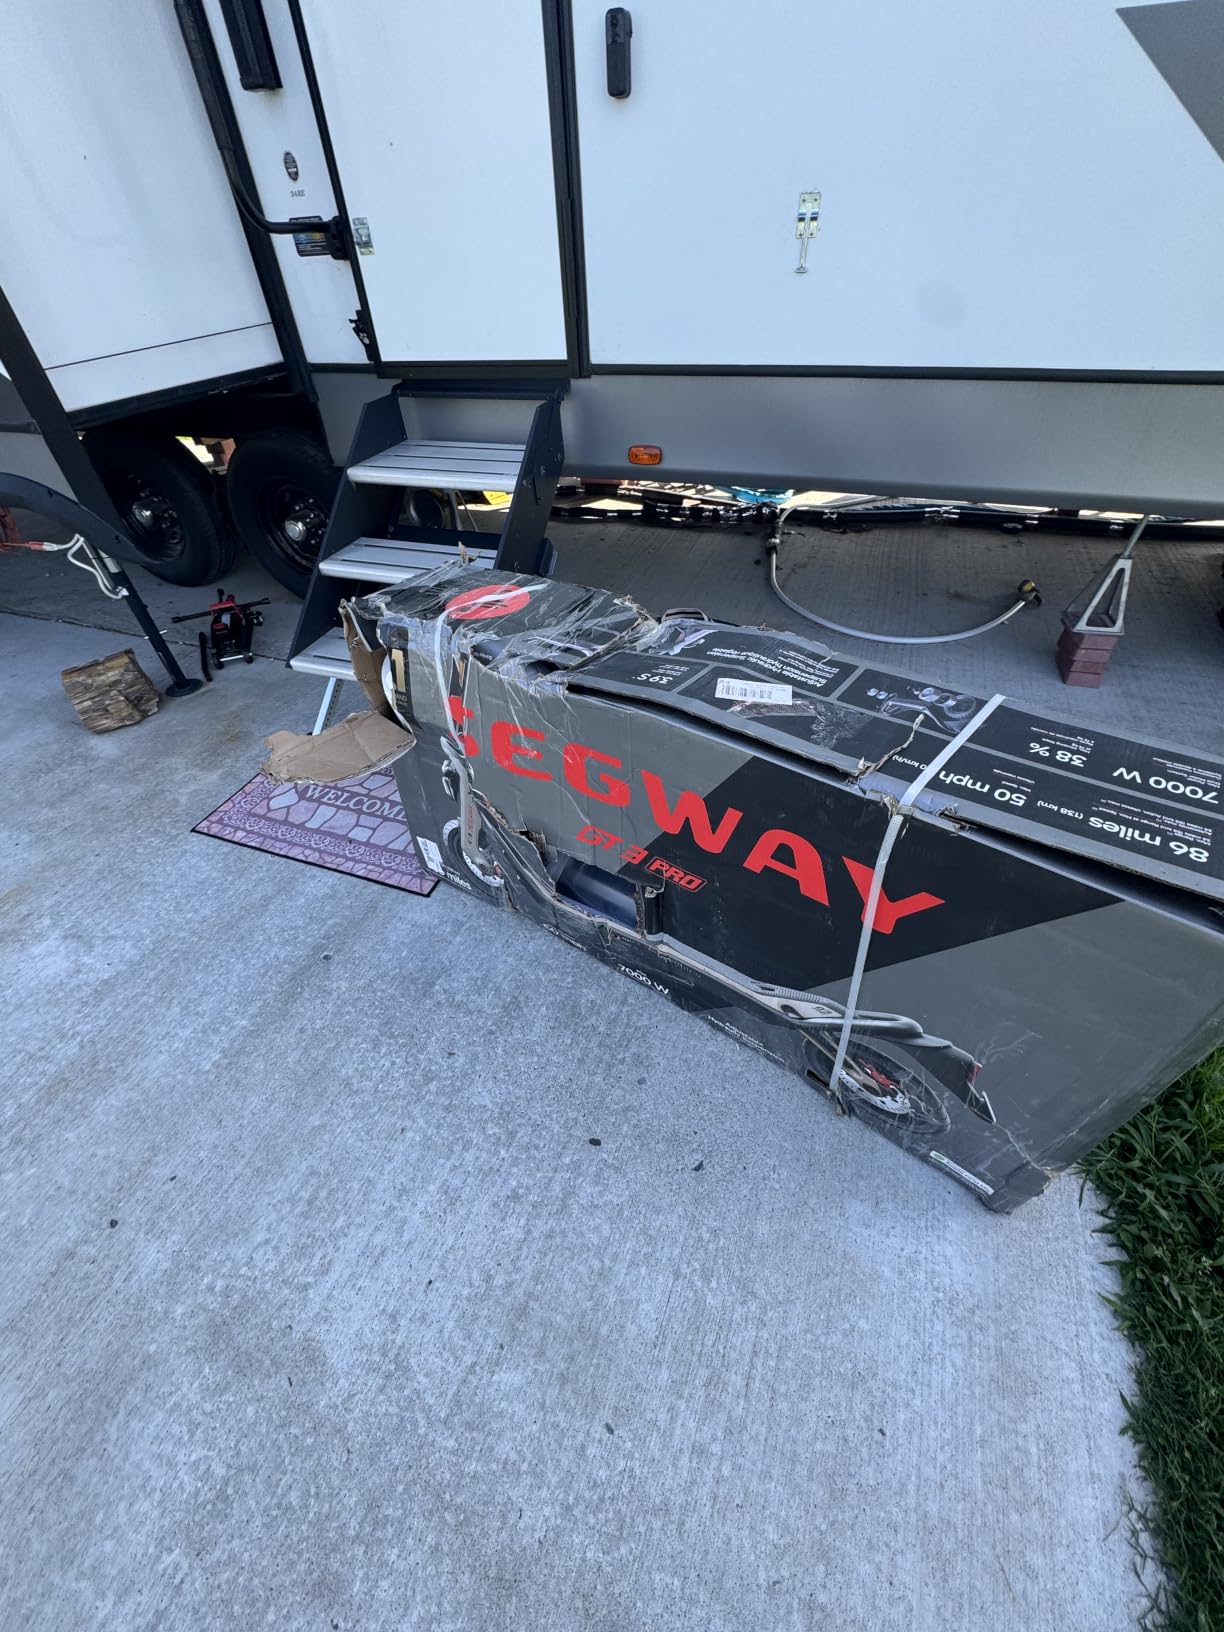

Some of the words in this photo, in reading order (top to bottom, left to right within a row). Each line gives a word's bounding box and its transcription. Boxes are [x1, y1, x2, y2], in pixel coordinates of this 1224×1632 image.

[1029, 742, 1051, 757] %
[1055, 750, 1087, 768] 38
[938, 769, 990, 793] mph
[1112, 767, 1142, 784] W
[993, 788, 1027, 807] 50
[1149, 776, 1219, 804] 7000
[1037, 800, 1059, 812] km)
[1059, 806, 1084, 821] (138
[1088, 816, 1162, 847] miles
[575, 823, 624, 852] GT
[620, 843, 649, 865] 3
[646, 858, 703, 890] PRO
[1169, 841, 1209, 863] 86
[653, 981, 669, 995] W
